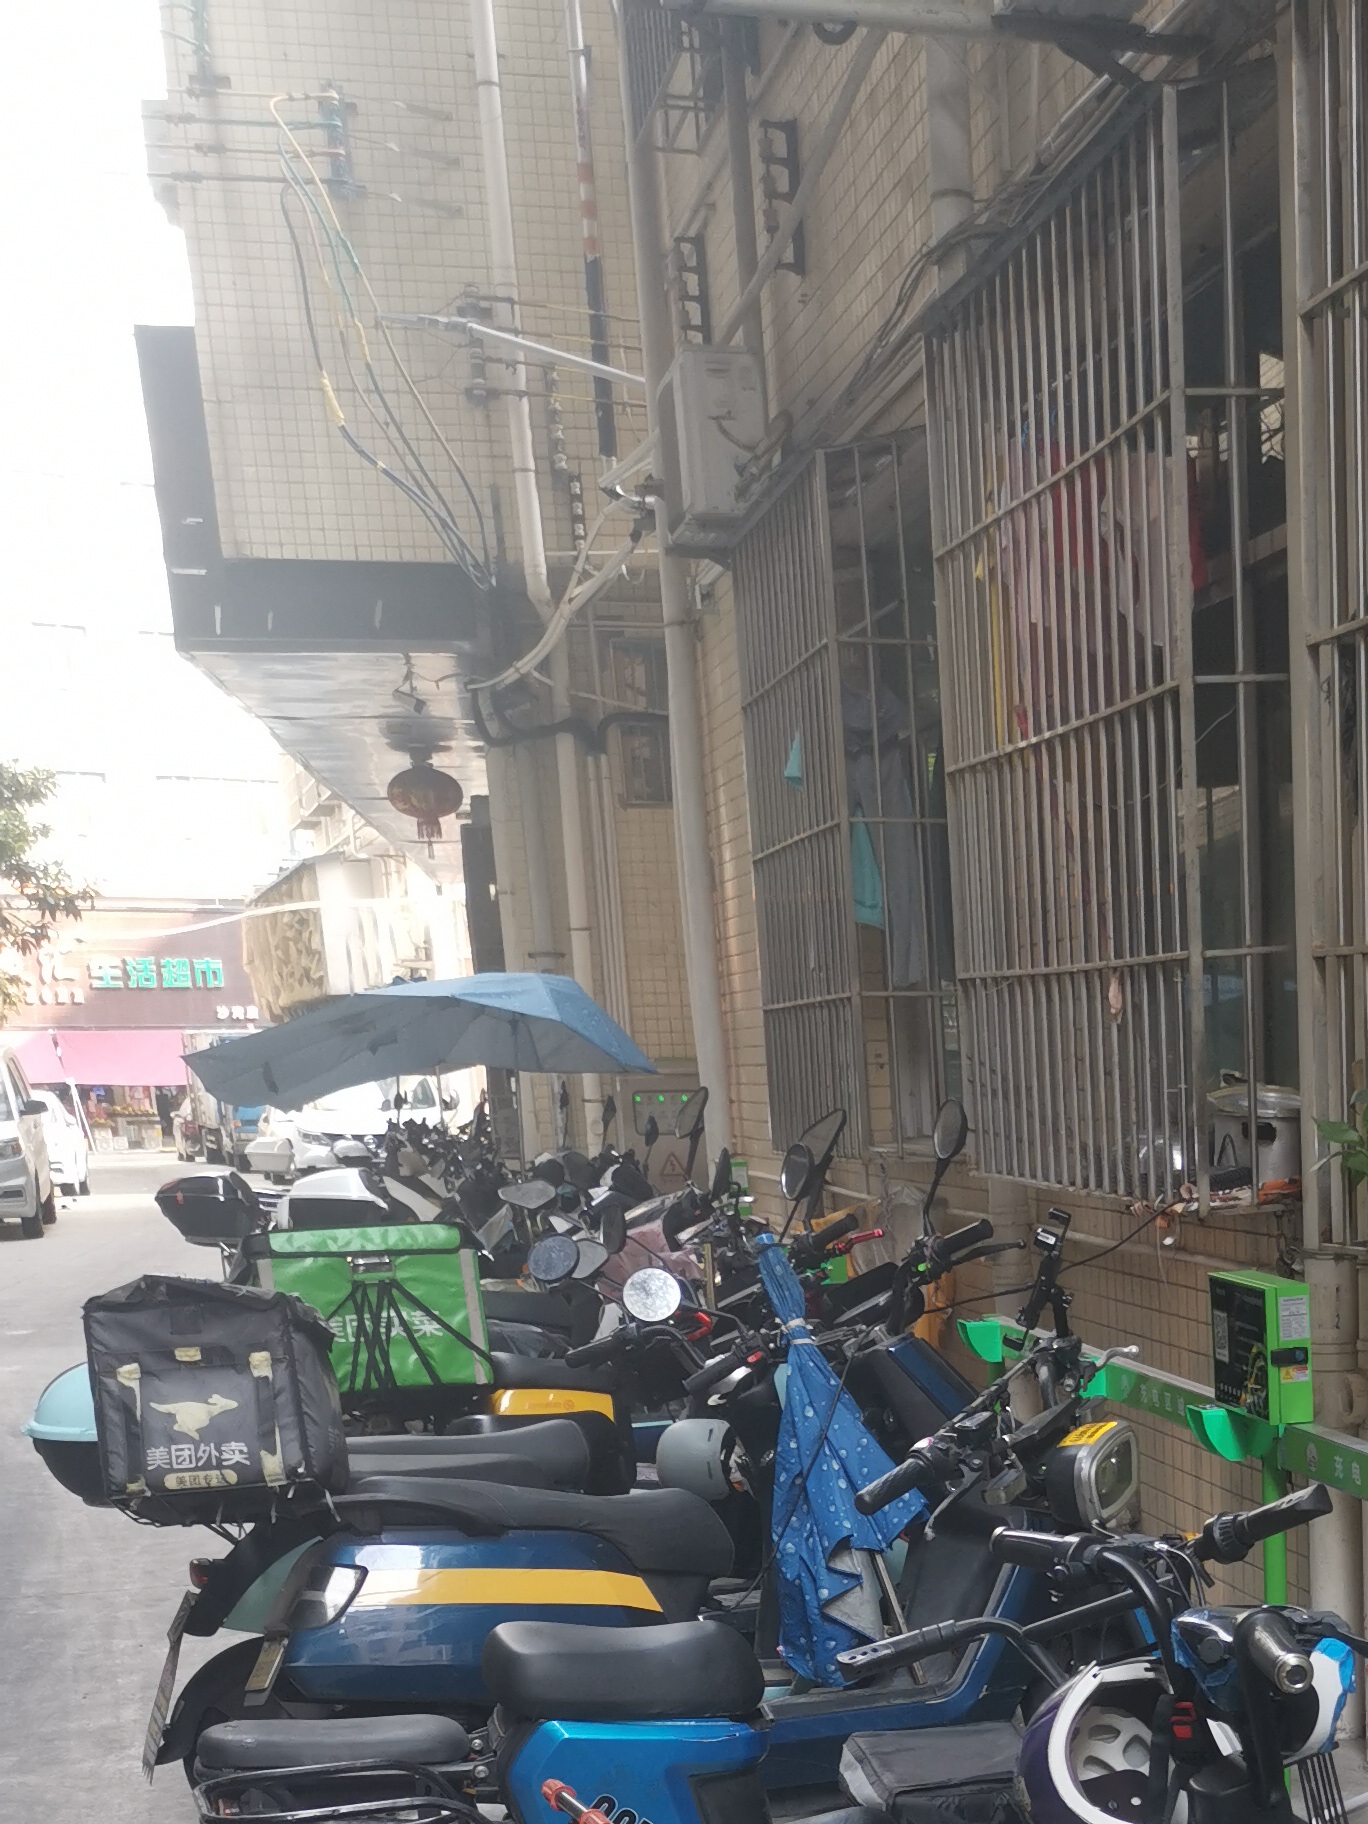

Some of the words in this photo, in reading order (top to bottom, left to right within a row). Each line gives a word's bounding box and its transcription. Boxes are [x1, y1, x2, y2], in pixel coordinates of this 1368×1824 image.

[89, 956, 225, 989] 生活超市
[146, 1441, 251, 1471] 美团外卖
